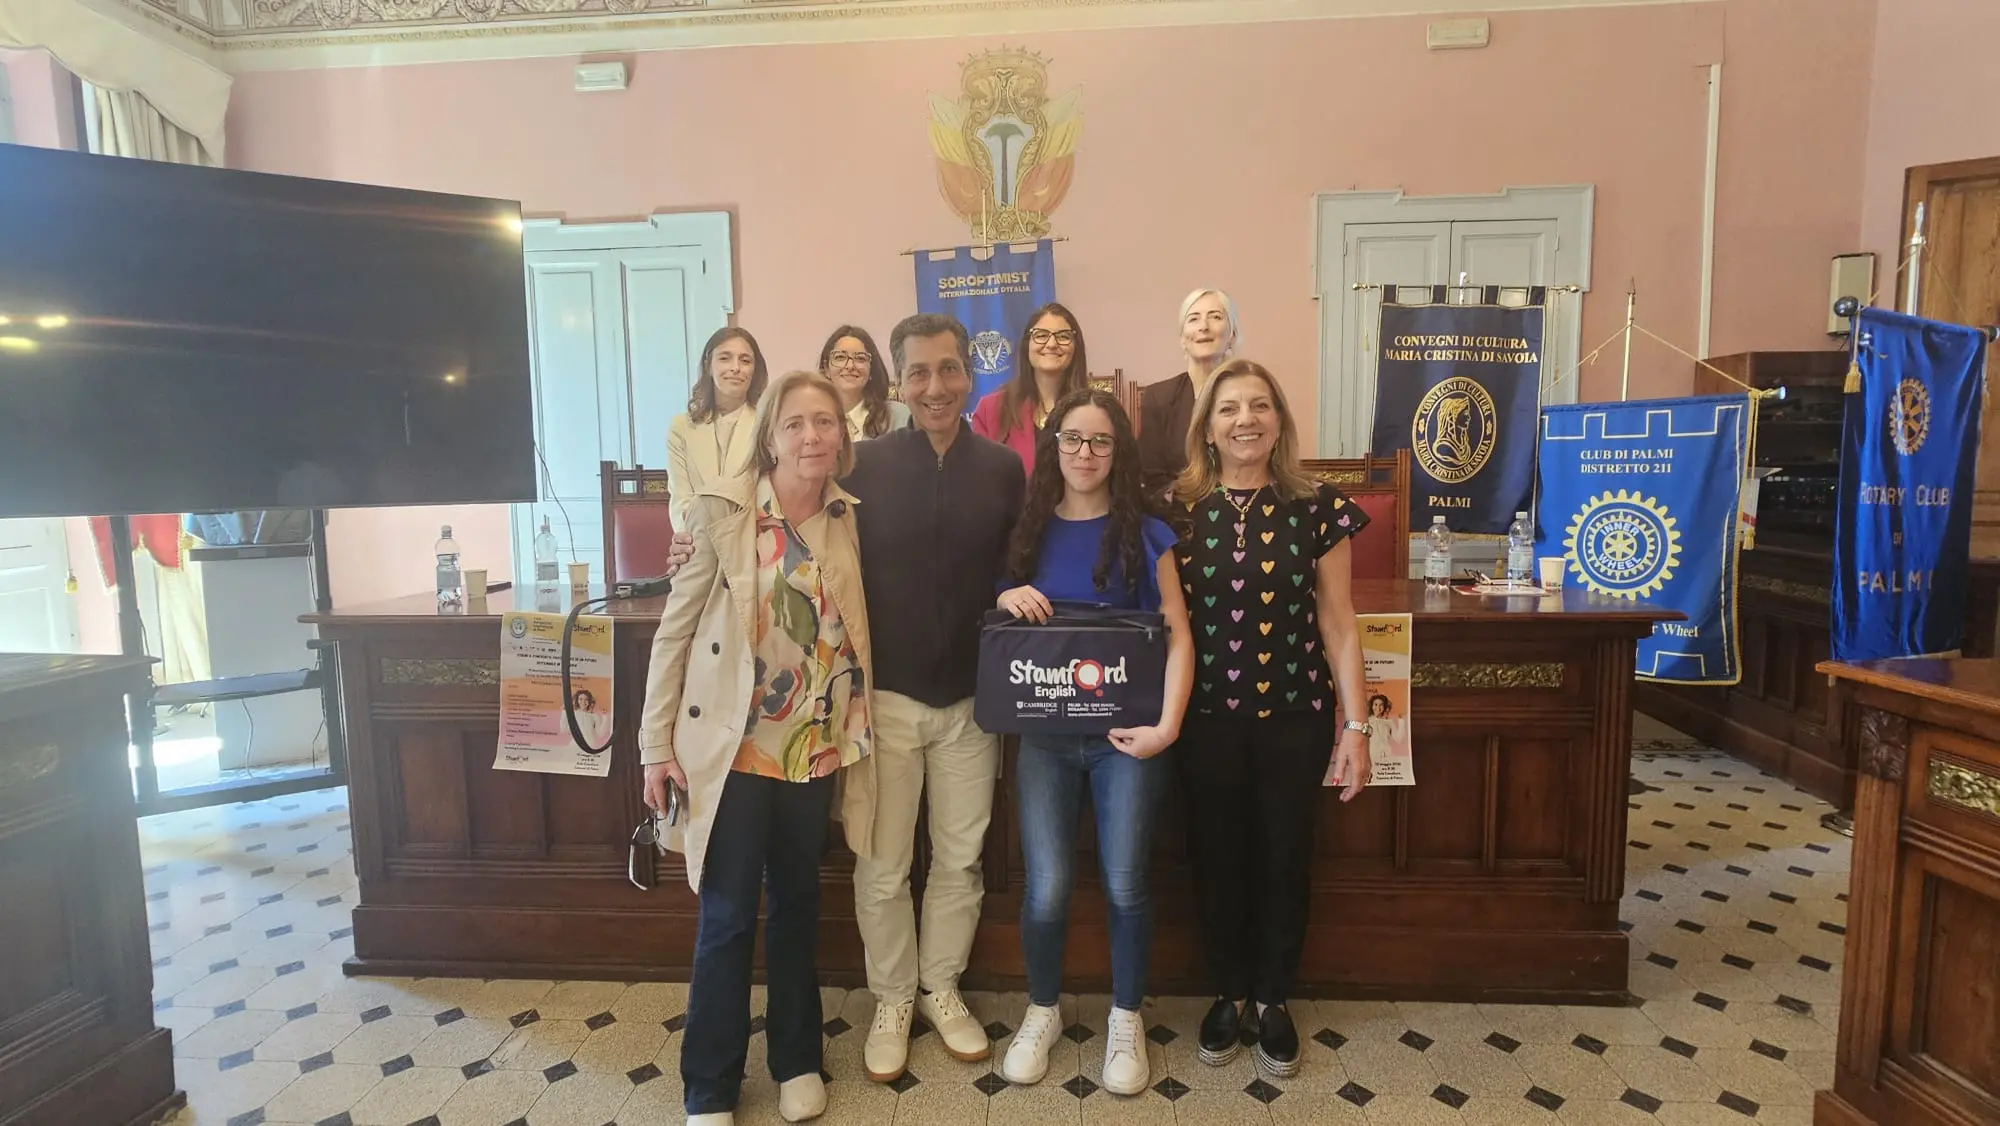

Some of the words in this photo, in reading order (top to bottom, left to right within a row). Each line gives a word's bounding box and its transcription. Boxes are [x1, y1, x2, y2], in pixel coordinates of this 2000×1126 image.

[938, 272, 1029, 289] SOROPTIMIST
[1394, 335, 1459, 347] CONVEGNI
[1462, 336, 1474, 347] DI
[1476, 336, 1528, 349] CULTURA
[1385, 349, 1422, 361] MARIA
[1424, 349, 1479, 362] CRISTINA
[1481, 351, 1494, 362] DI
[1496, 352, 1538, 363] SAVOIA
[1422, 382, 1457, 414] CONVEGNI
[1458, 382, 1467, 391] DI
[1467, 385, 1491, 416] CULTURA
[1417, 440, 1433, 468] MARIA
[1580, 449, 1612, 460] CLUB
[1614, 449, 1628, 460] DI
[1632, 448, 1674, 459] PALMI
[1581, 463, 1650, 473] DISTRETTO
[1653, 463, 1671, 473] 211
[1428, 495, 1471, 508] PALMI
[1860, 482, 1906, 506] ROTARY
[1600, 522, 1640, 537] INNER
[1598, 553, 1641, 570] WHEEL
[1859, 570, 1933, 593] PALMI
[1661, 623, 1699, 638] Wheel
[1035, 685, 1076, 699] English
